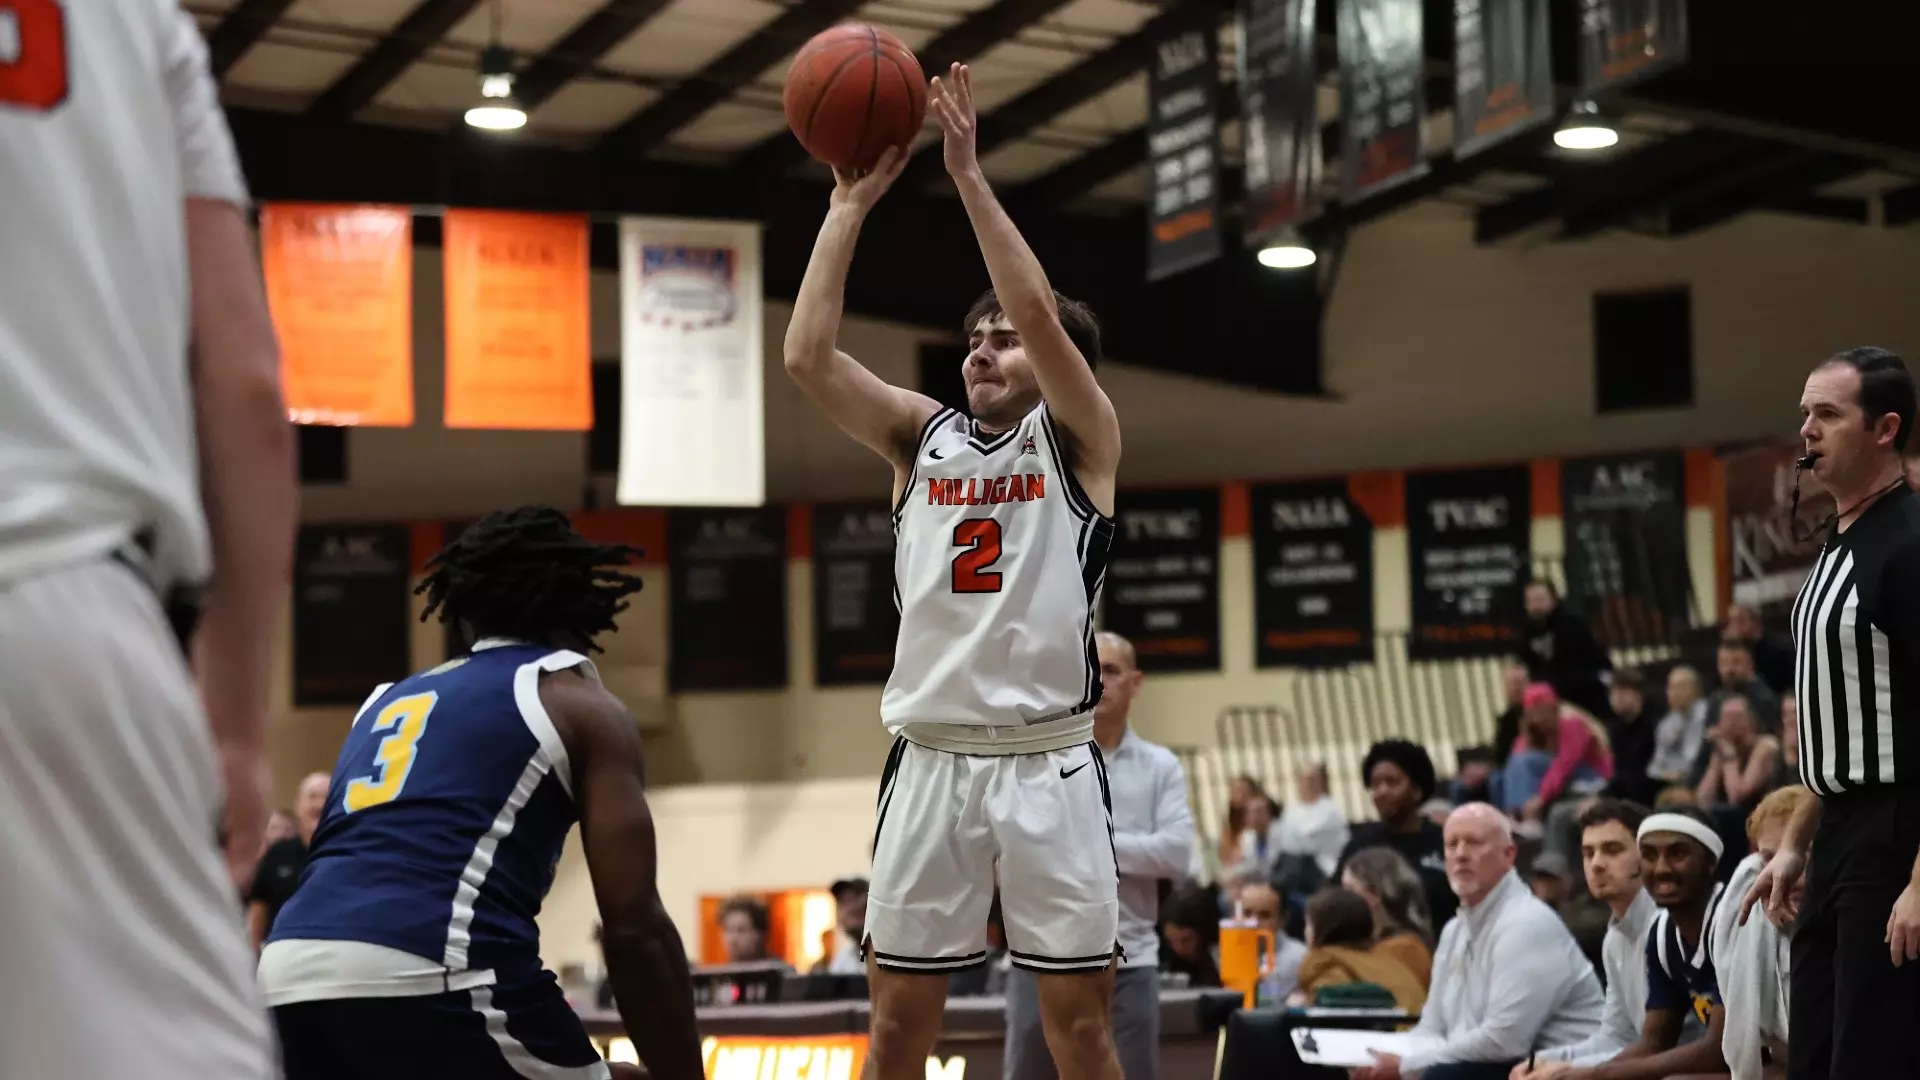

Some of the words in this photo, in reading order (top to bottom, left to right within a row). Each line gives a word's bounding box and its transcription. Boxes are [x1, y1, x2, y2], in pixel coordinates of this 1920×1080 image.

[928, 474, 1045, 506] MILLIGAN
[952, 517, 1003, 593] 2
[343, 690, 439, 815] 3
